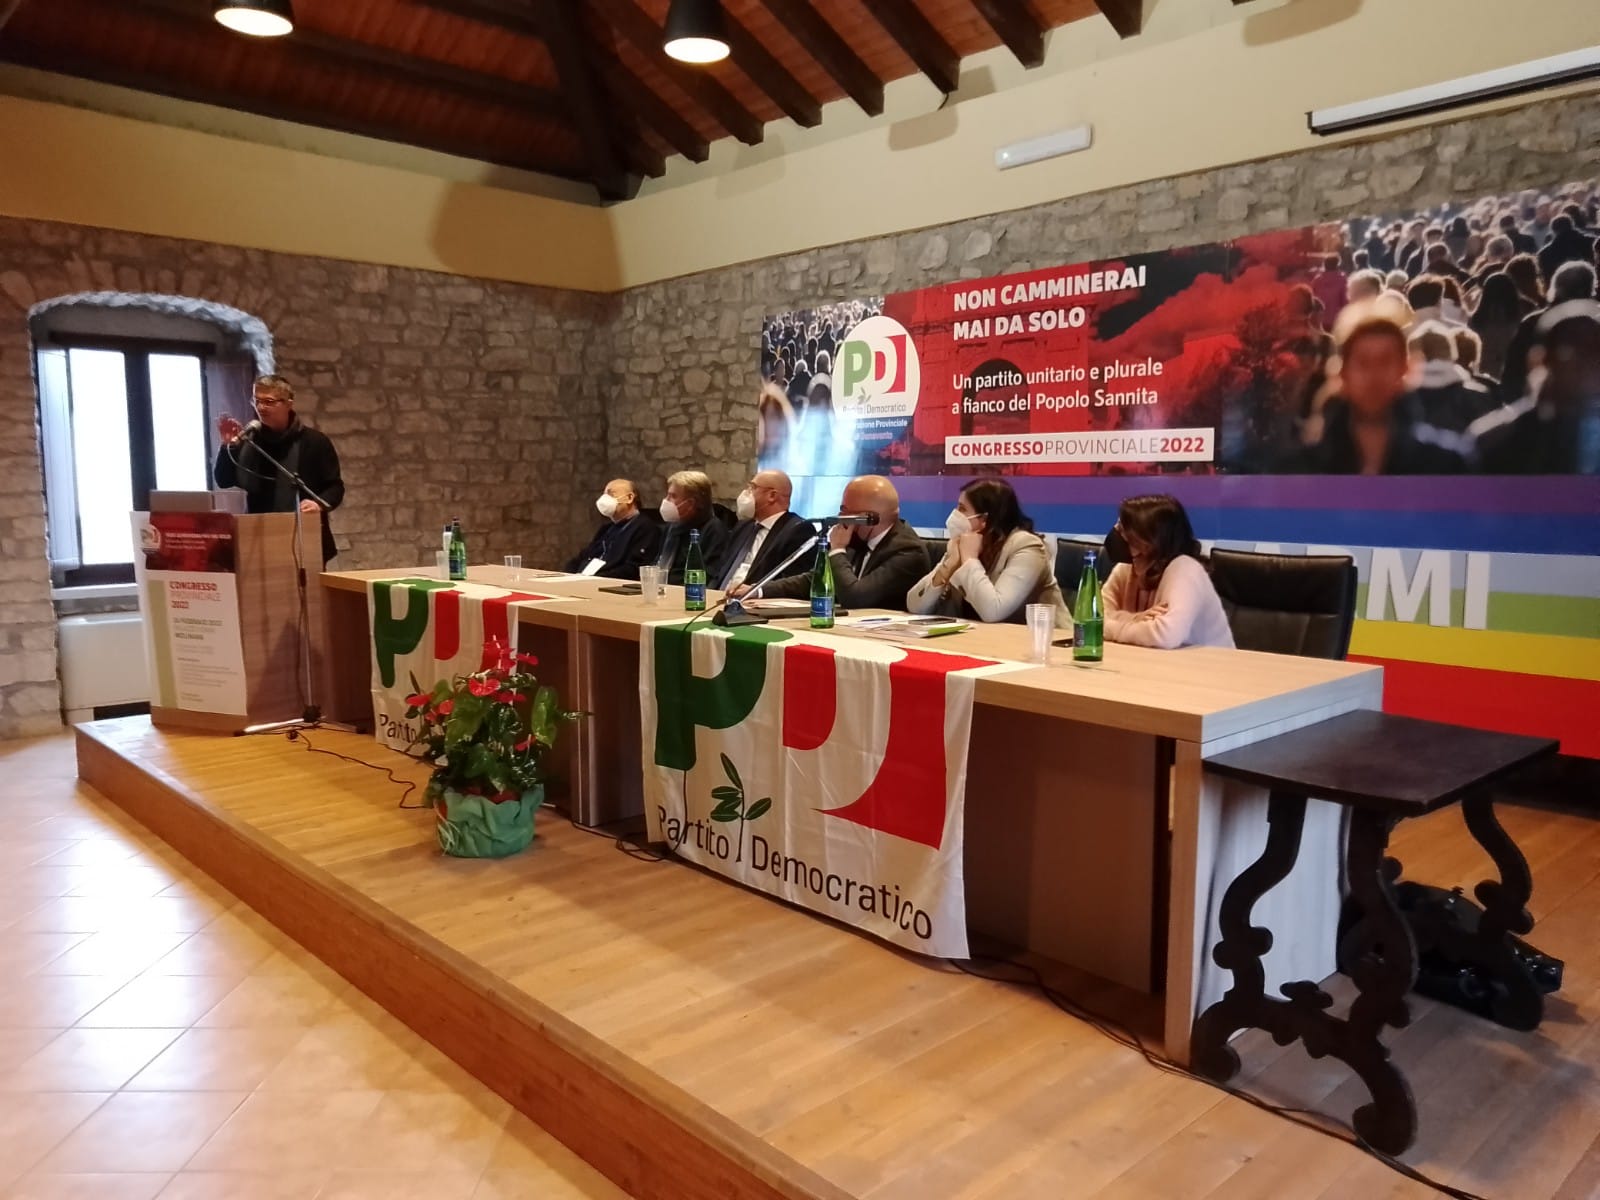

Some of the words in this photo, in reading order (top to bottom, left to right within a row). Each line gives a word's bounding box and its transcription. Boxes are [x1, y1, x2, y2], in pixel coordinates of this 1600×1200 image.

[954, 288, 996, 312] NON
[1000, 265, 1147, 305] CAMMINERAI
[953, 318, 990, 341] MAI
[995, 314, 1024, 336] DA
[1028, 306, 1086, 332] SOLO
[952, 374, 972, 390] Un
[975, 370, 1023, 392] partito
[1026, 365, 1085, 385] unitario
[1090, 368, 1099, 380] e
[1103, 357, 1163, 383] plurale
[866, 403, 906, 414] Democratico
[951, 402, 960, 415] a
[963, 396, 1005, 414] fianco
[1008, 393, 1031, 412] del
[1036, 390, 1090, 413] Popolo
[1094, 387, 1158, 407] Sannita
[875, 418, 908, 428] Provinciale
[657, 804, 730, 861] Partito
[750, 835, 933, 940] Democratico
